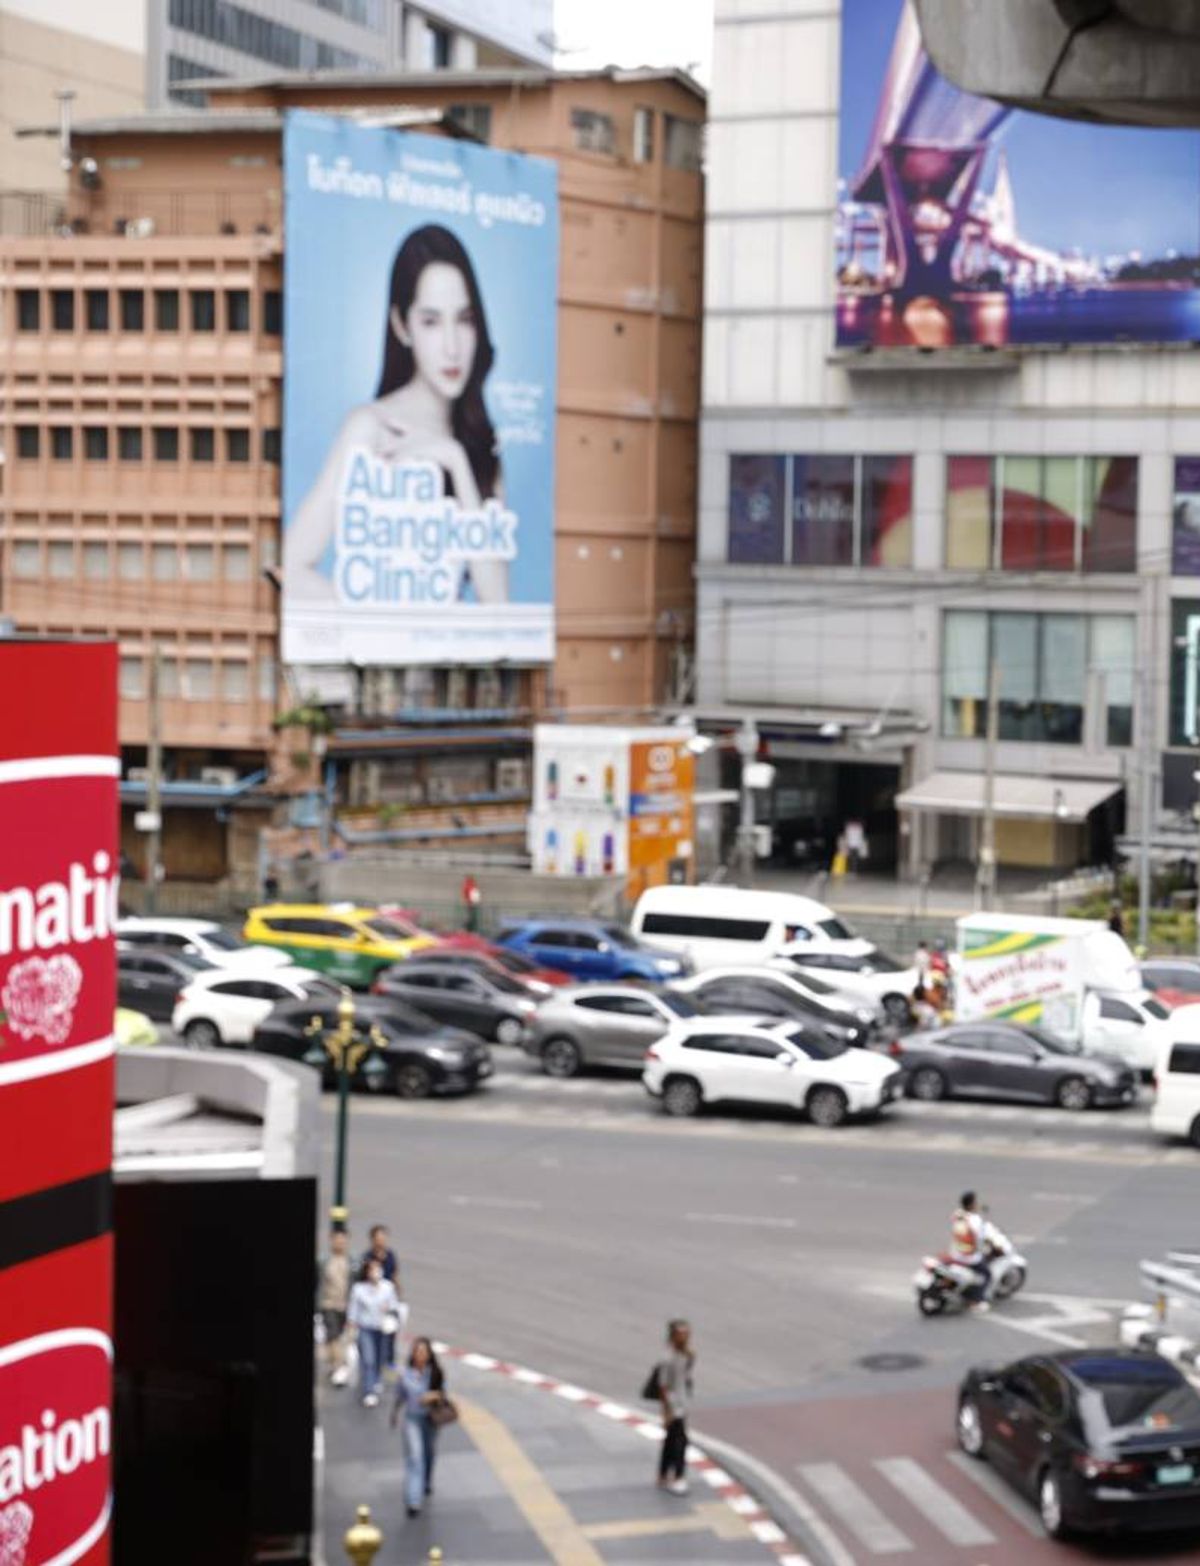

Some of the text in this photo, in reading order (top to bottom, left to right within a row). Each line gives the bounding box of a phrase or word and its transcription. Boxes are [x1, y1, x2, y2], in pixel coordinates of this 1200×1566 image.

[345, 452, 437, 499] Aura
[342, 504, 513, 563] Bangkok
[341, 554, 451, 602] Clinic
